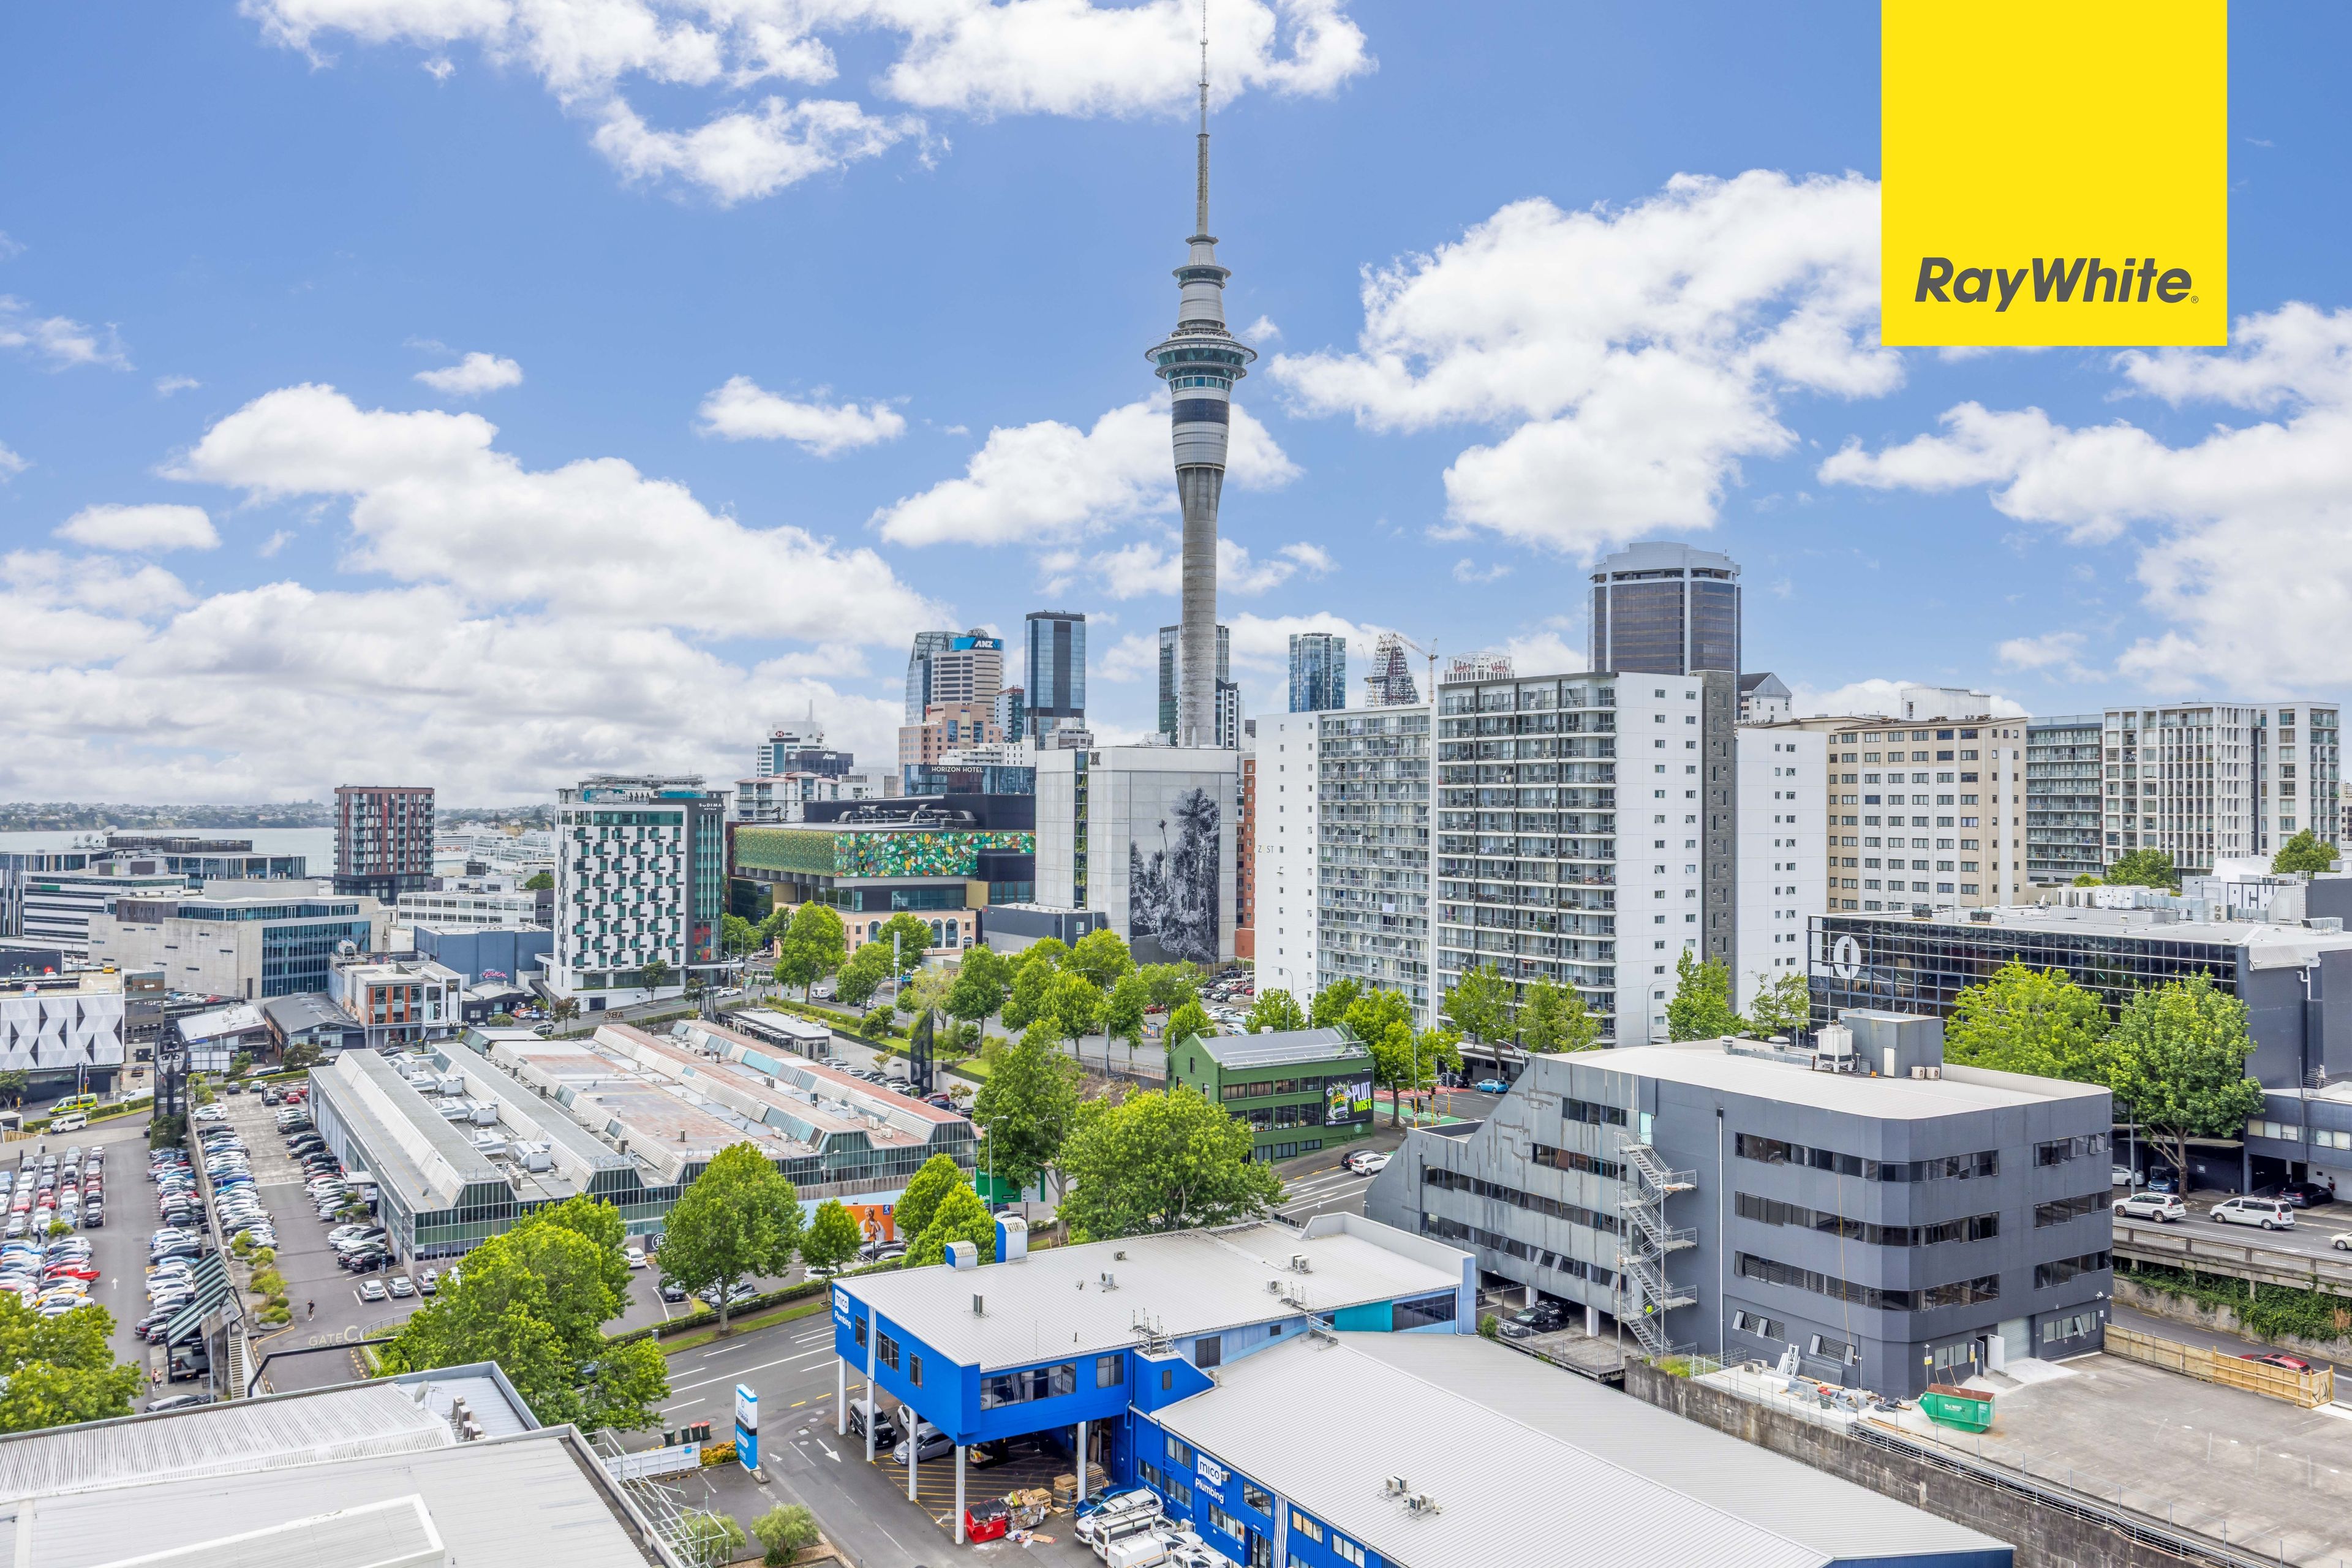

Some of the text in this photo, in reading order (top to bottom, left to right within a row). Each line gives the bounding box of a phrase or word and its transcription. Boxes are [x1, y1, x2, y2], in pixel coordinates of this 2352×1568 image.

[1258, 845, 1274, 853] ZST
[1351, 1081, 1371, 1102] PLOT
[1353, 1098, 1372, 1112] TWIST
[837, 1295, 848, 1308] mico
[835, 1310, 851, 1330] Plumbing
[309, 1325, 358, 1346] GATE C
[1200, 1461, 1219, 1480] mico
[1196, 1477, 1224, 1504] Plumbing
